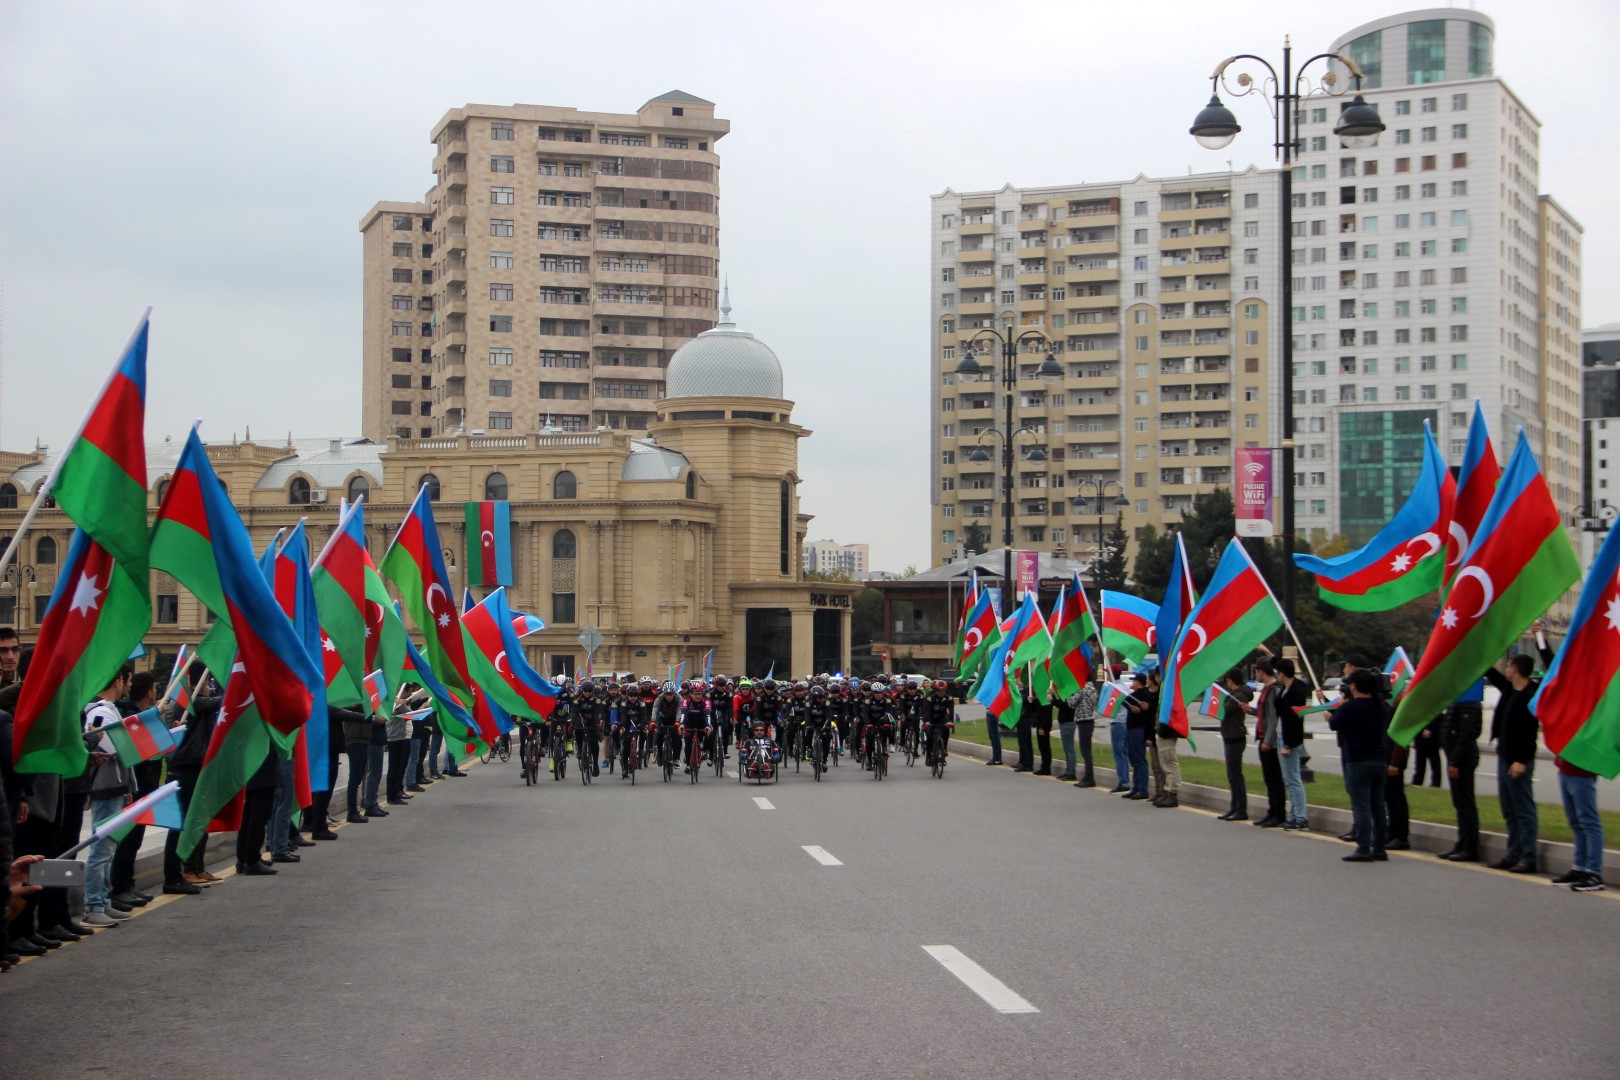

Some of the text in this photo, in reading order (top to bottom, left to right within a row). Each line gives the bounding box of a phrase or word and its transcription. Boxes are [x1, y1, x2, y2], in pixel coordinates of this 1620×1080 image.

[1243, 490, 1265, 499] WiFi
[810, 593, 850, 607] PARK HOTEL
